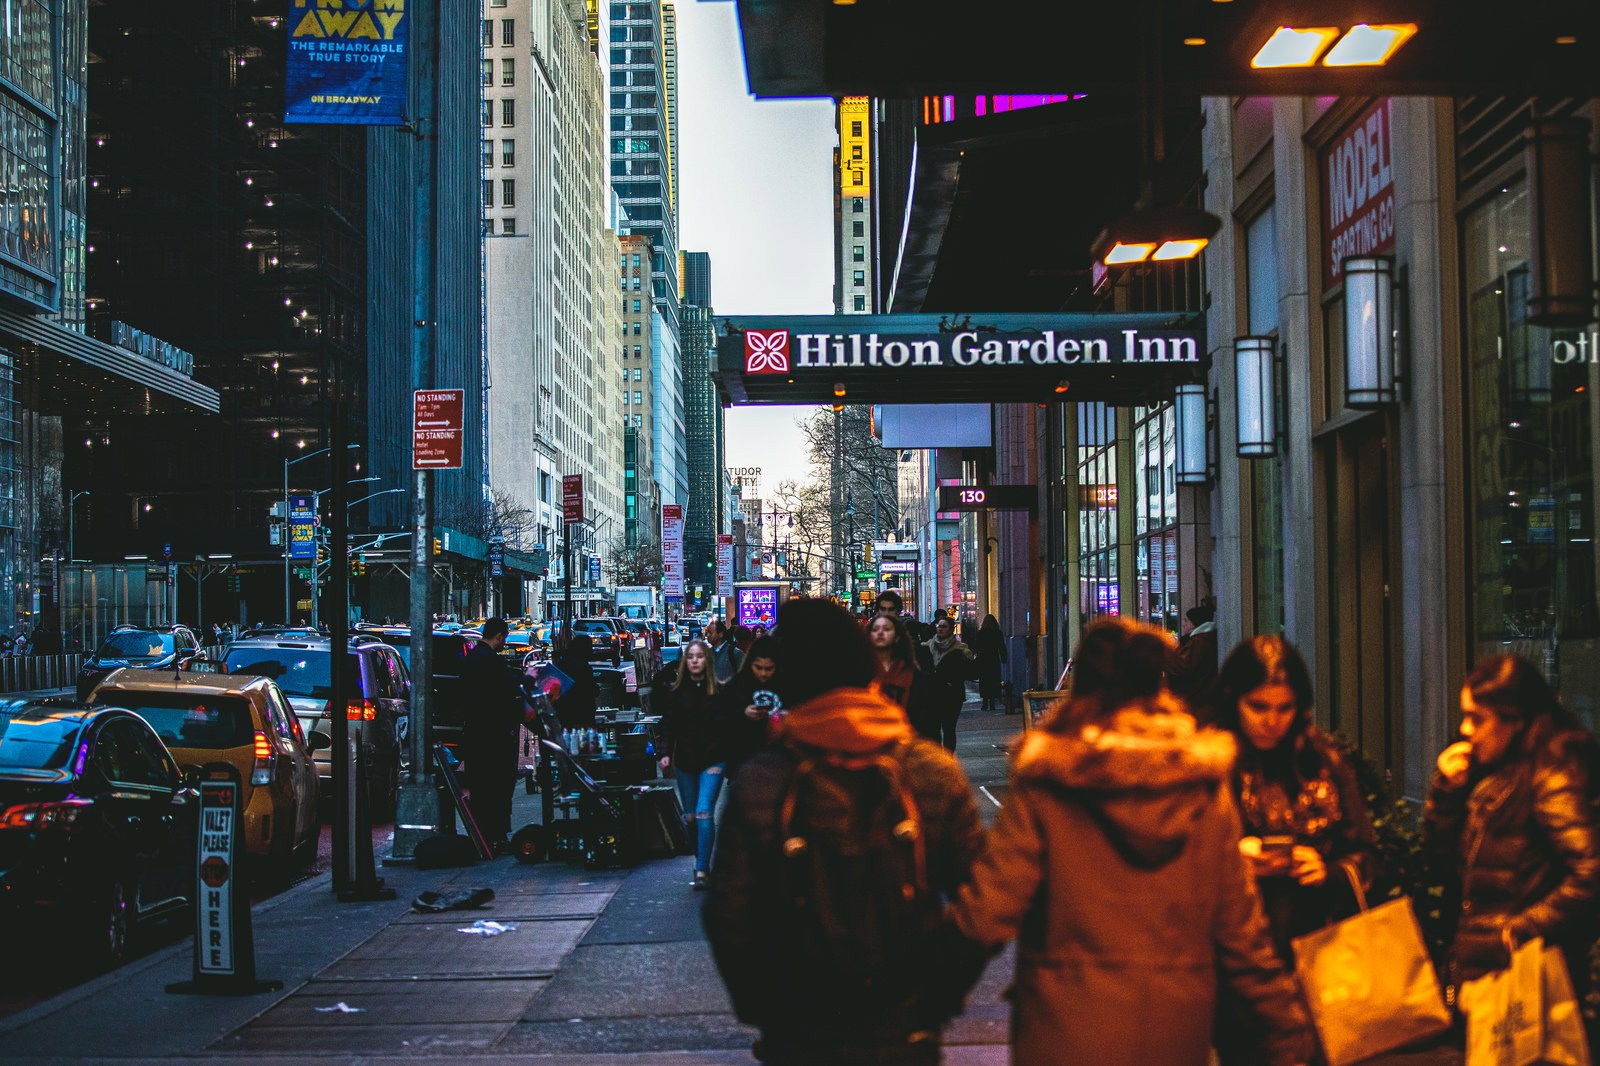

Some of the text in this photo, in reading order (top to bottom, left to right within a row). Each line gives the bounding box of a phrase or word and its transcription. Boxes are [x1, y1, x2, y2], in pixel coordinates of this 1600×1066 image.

[292, 9, 404, 40] AWAY
[291, 41, 403, 53] THE REMARKABLE
[308, 52, 386, 63] TRUE STORY
[311, 95, 381, 104] ON BROADWAY
[796, 330, 1199, 367] Hilton Garden Inn
[417, 393, 456, 402] NO STANDING
[416, 432, 455, 440] NO STANDING
[728, 467, 762, 476] TUDOR
[960, 490, 985, 503] 130
[205, 811, 231, 833] VALET
[203, 834, 229, 853] PLEASE
[208, 891, 222, 966] HERE
